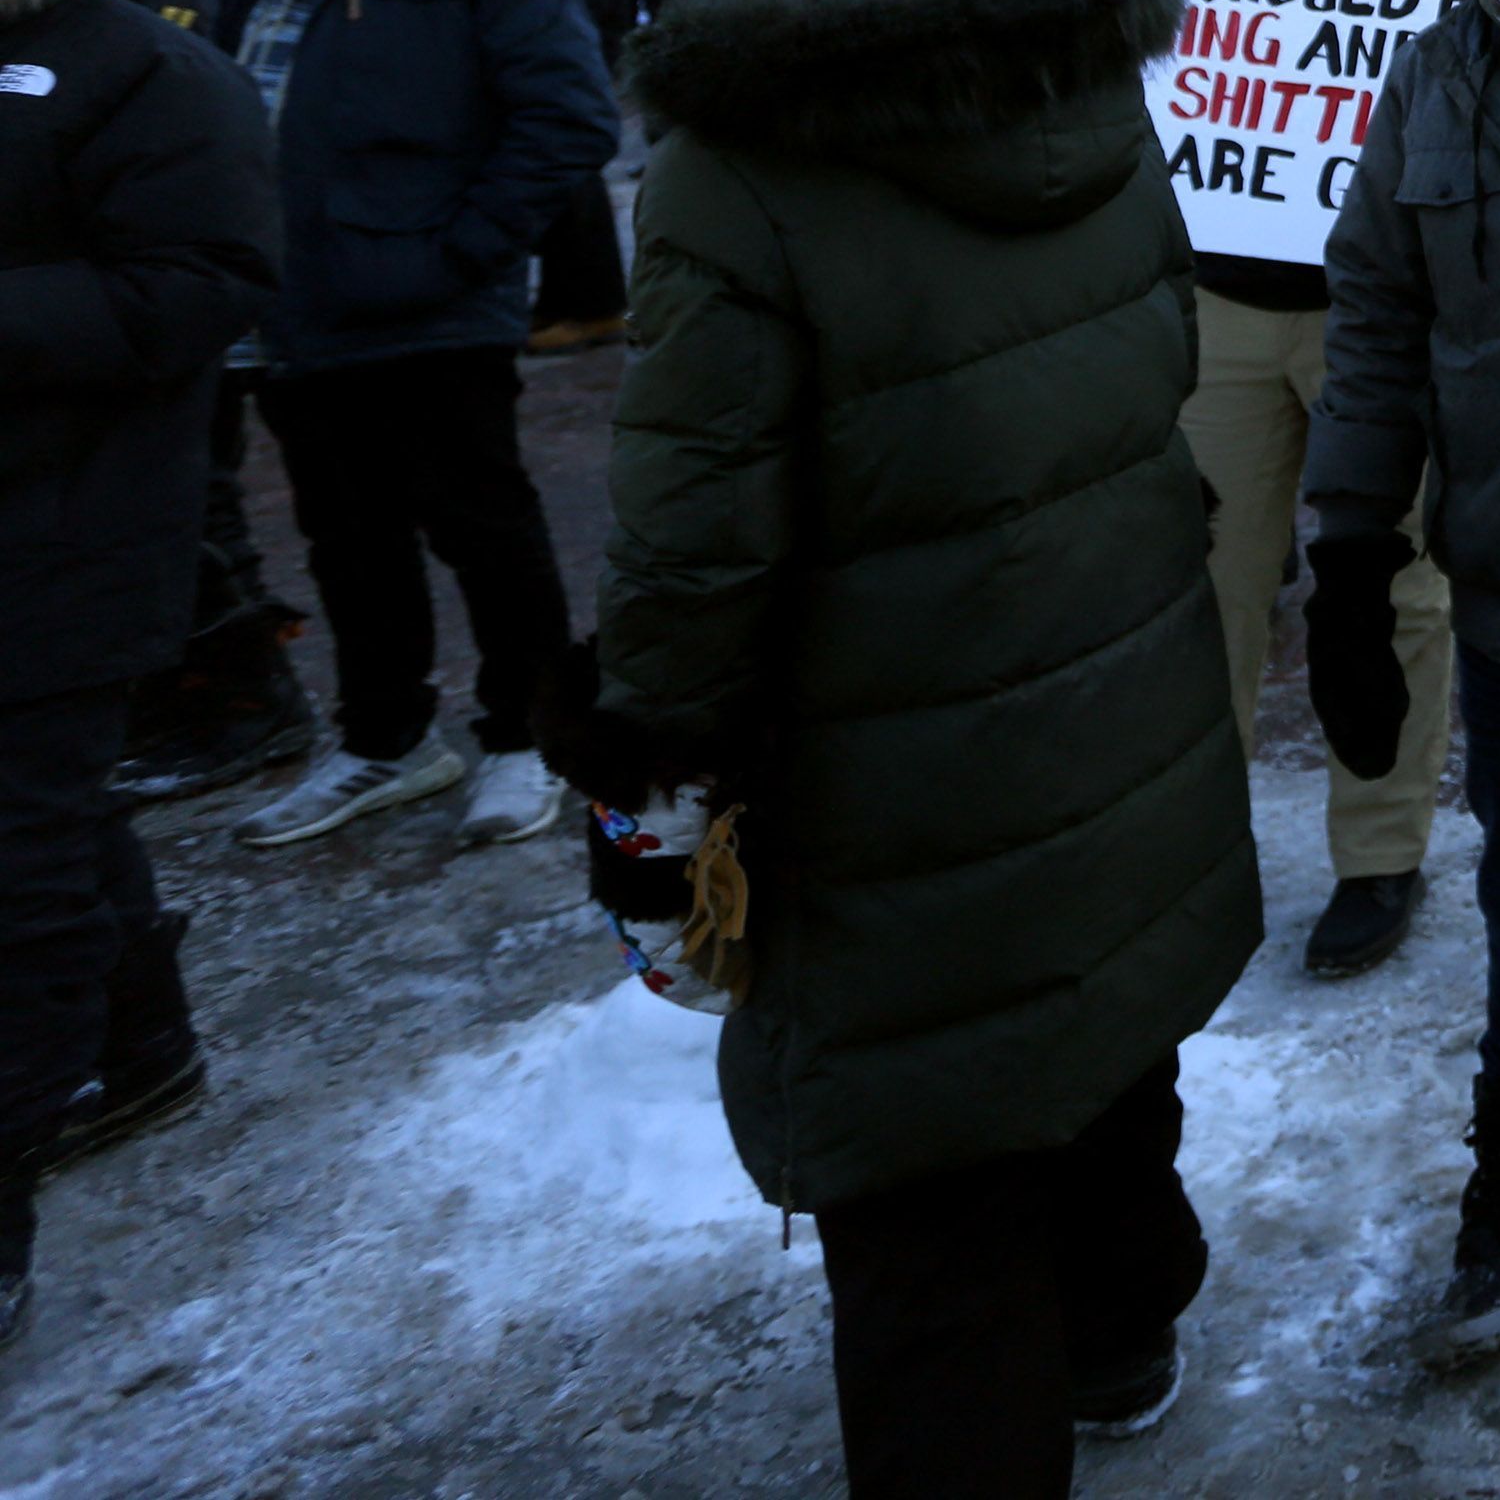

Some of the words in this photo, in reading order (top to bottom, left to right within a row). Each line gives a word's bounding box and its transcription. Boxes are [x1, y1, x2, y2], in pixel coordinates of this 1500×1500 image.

[1178, 6, 1282, 67] ING
[1168, 66, 1373, 147] SHITTI
[1168, 134, 1296, 203] ARE
